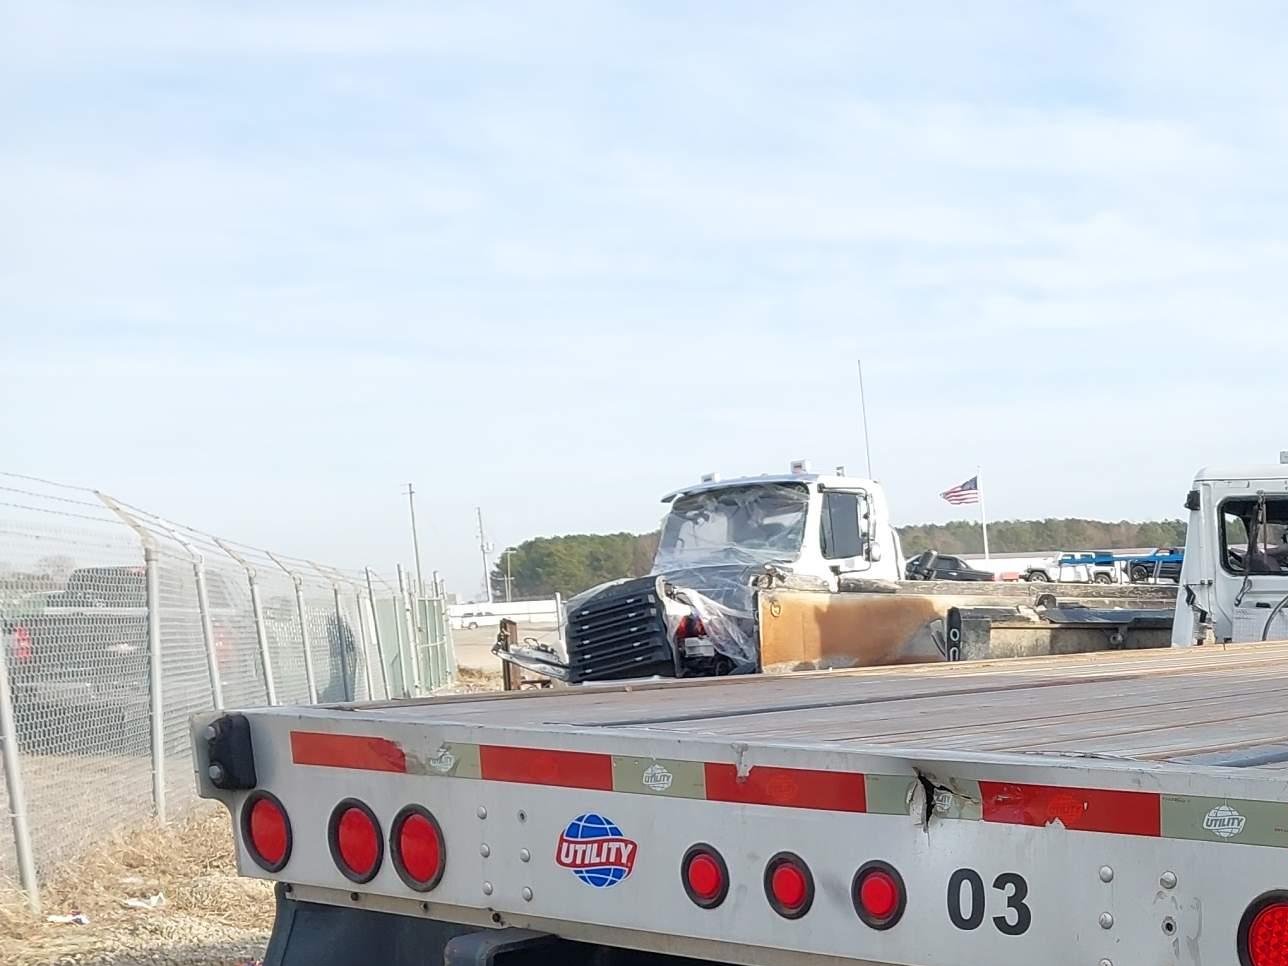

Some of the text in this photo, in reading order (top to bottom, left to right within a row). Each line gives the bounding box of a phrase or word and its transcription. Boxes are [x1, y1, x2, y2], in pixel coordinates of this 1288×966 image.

[644, 773, 671, 783] UTILITY
[1205, 817, 1243, 828] UTILITY
[560, 842, 633, 865] UTILITY
[946, 867, 1032, 936] 03
